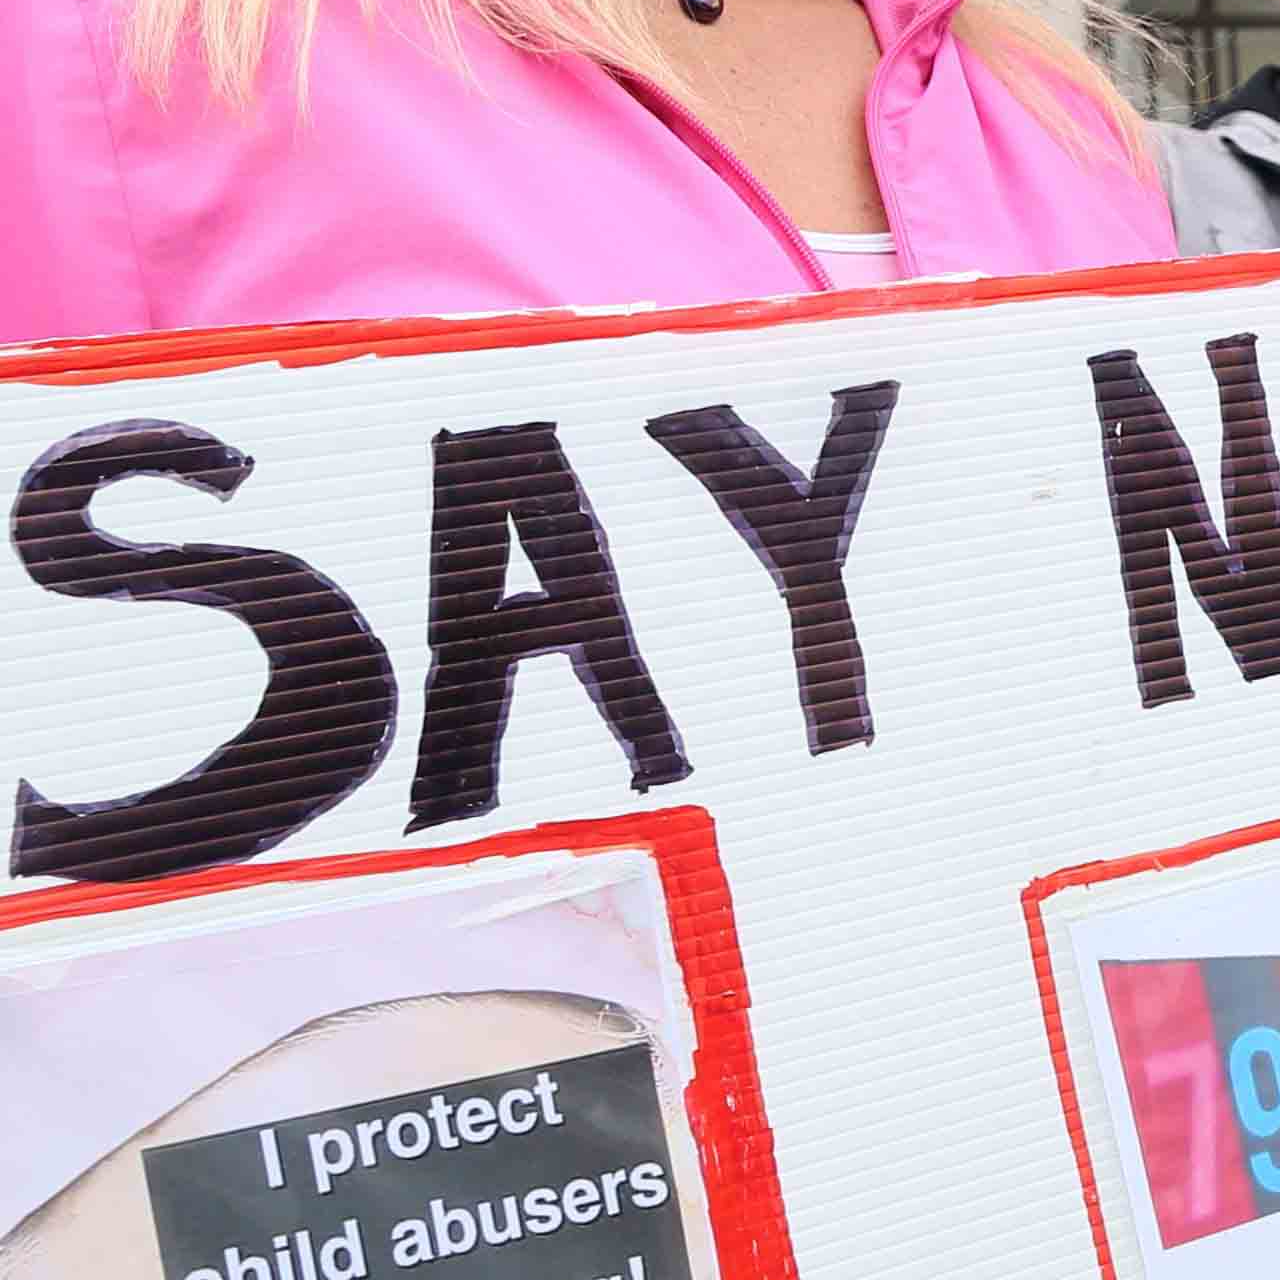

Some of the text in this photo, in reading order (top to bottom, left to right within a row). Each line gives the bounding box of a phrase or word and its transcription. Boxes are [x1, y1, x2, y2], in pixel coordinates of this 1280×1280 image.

[9, 379, 902, 884] SAY
[258, 1071, 565, 1194] I protect
[391, 1160, 670, 1268] abusers
